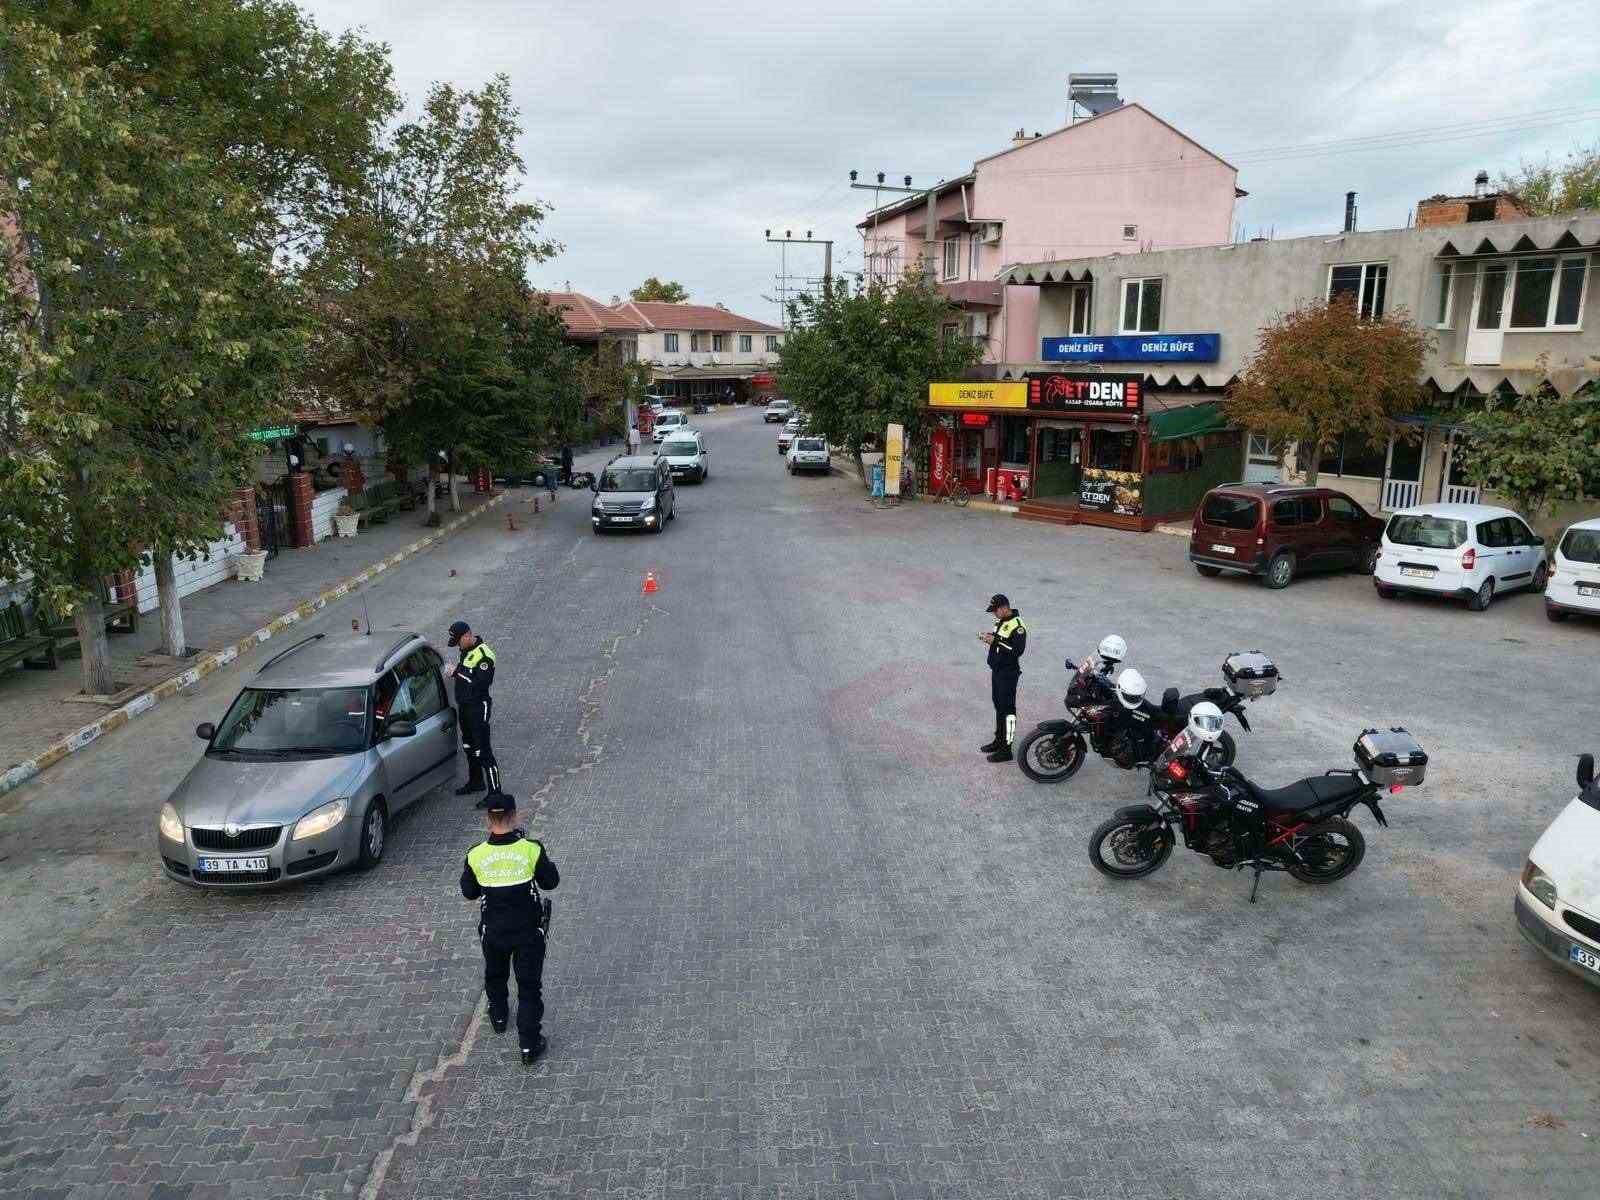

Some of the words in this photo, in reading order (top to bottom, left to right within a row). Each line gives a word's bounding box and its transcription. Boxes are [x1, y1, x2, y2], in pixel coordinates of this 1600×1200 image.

[1058, 342, 1082, 353] DENİZ
[1082, 342, 1104, 353] BÜFE
[1141, 341, 1168, 353] DENİZ
[1169, 340, 1194, 352] BÜFE
[206, 860, 219, 870] 39
[225, 860, 238, 870] TA
[246, 859, 266, 869] 410
[1579, 951, 1595, 967] 39
